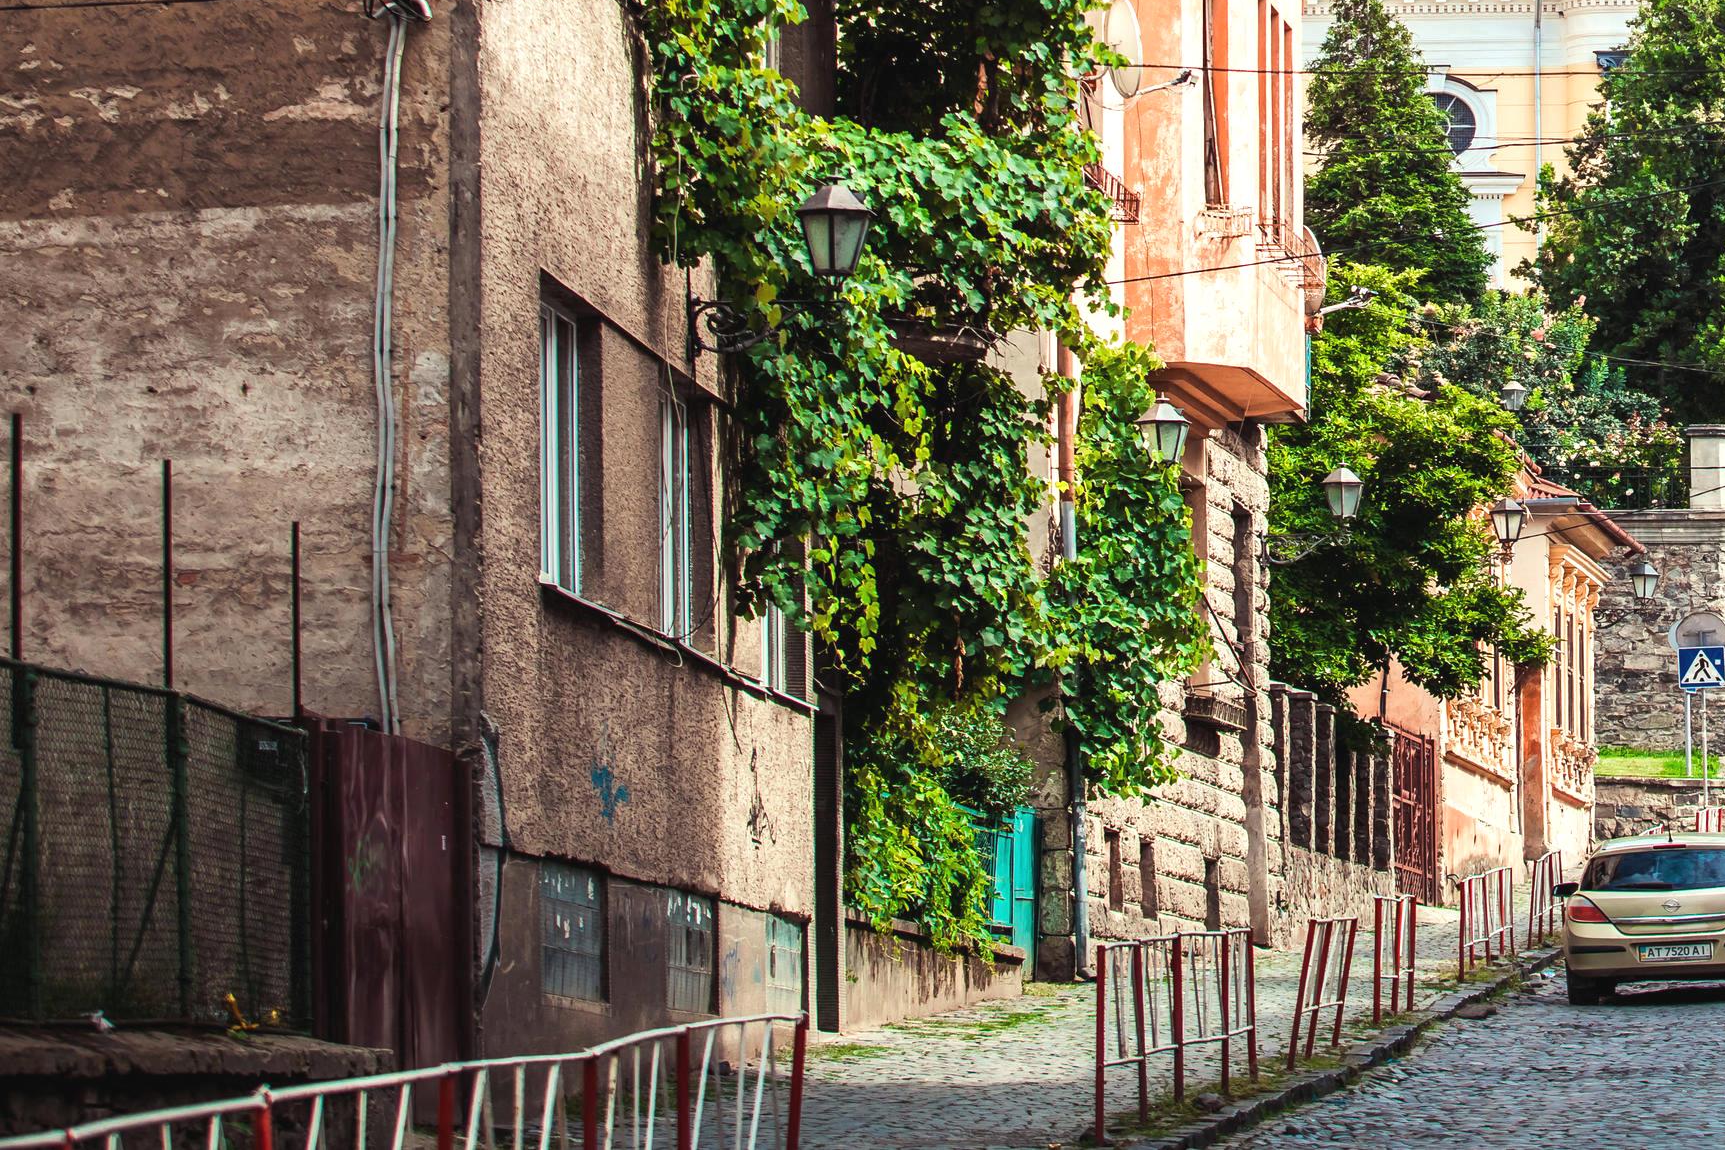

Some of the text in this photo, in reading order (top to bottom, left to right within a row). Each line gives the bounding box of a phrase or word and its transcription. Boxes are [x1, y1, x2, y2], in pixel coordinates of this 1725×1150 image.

[1647, 945, 1705, 957] AT 7520 AI
